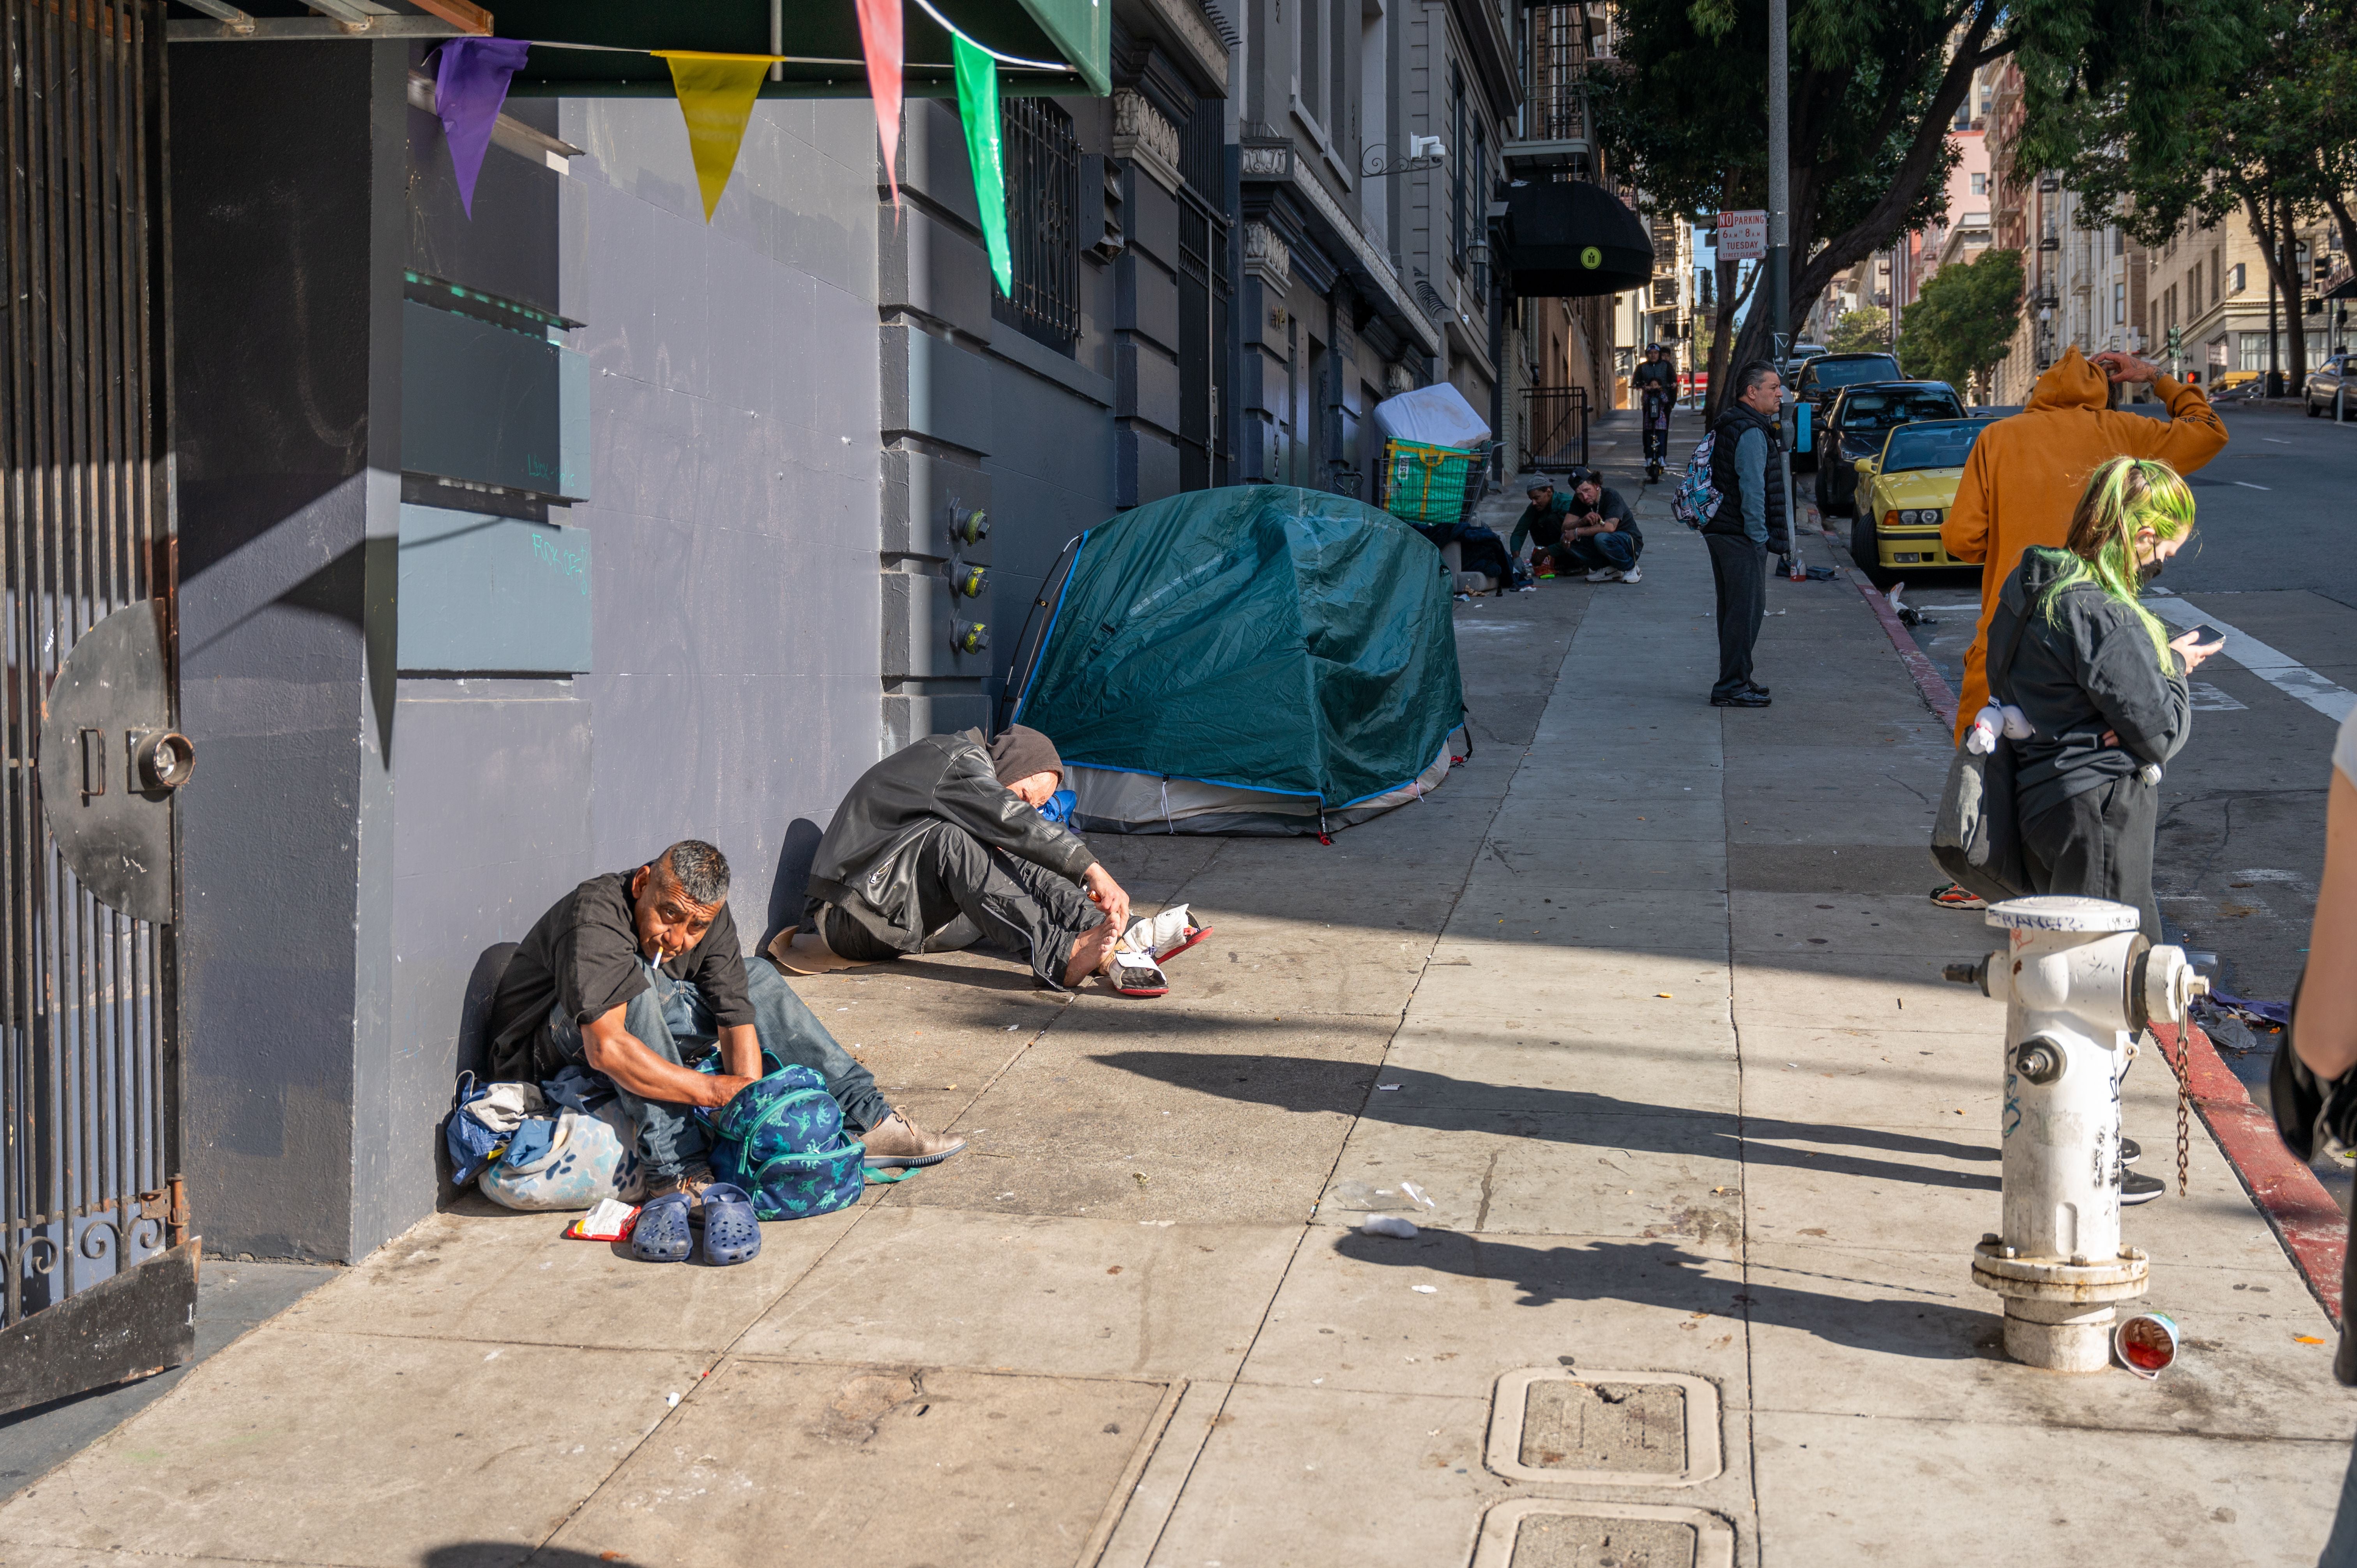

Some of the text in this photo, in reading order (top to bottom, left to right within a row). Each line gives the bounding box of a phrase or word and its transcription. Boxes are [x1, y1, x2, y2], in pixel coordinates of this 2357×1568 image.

[1719, 214, 1764, 226] NO PARKING
[1723, 230, 1728, 238] 6
[1746, 228, 1749, 237] 8
[1727, 241, 1758, 249] TUESDAY
[532, 533, 565, 574] FUCK
